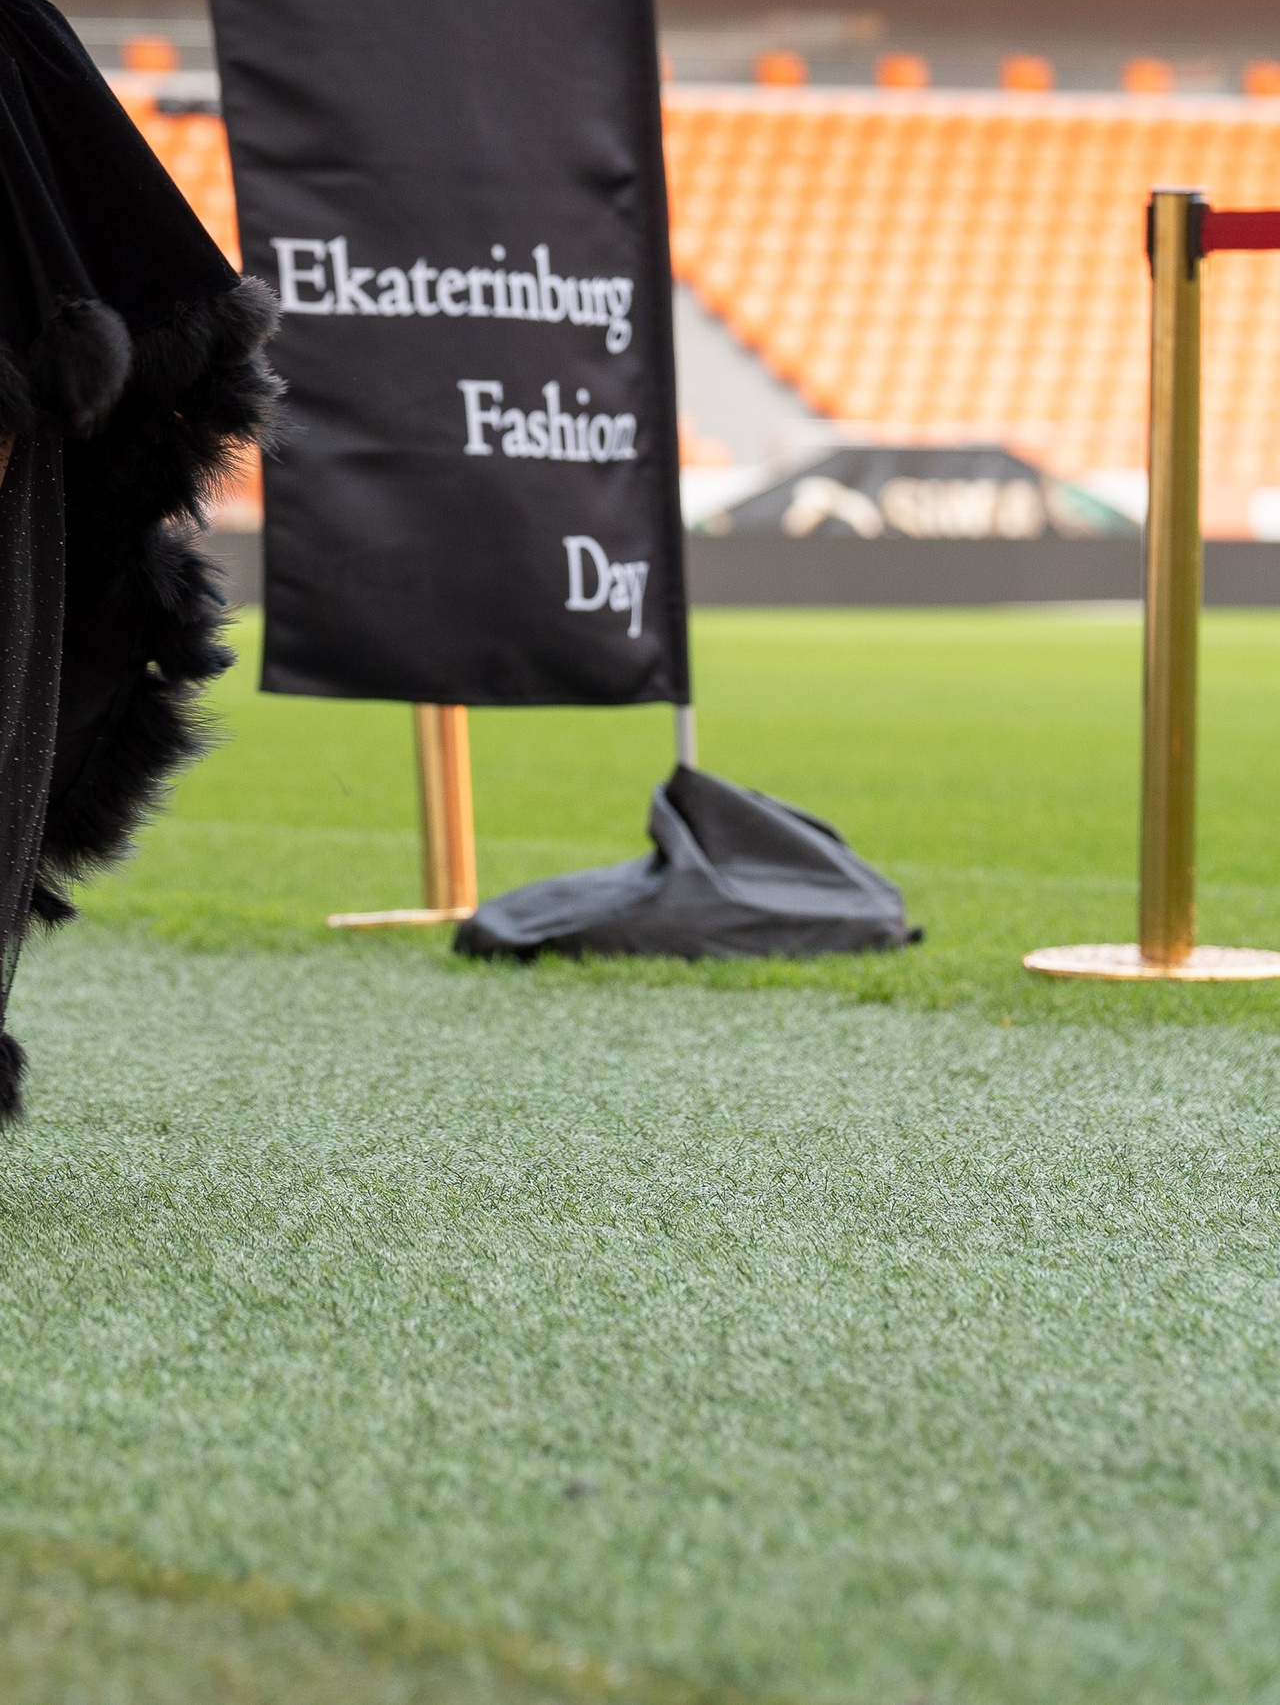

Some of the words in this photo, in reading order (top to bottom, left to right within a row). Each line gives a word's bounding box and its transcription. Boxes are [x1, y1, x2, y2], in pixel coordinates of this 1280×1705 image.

[271, 236, 633, 354] Ekaterinburg
[457, 379, 638, 461] Fashion
[563, 535, 649, 638] Day
